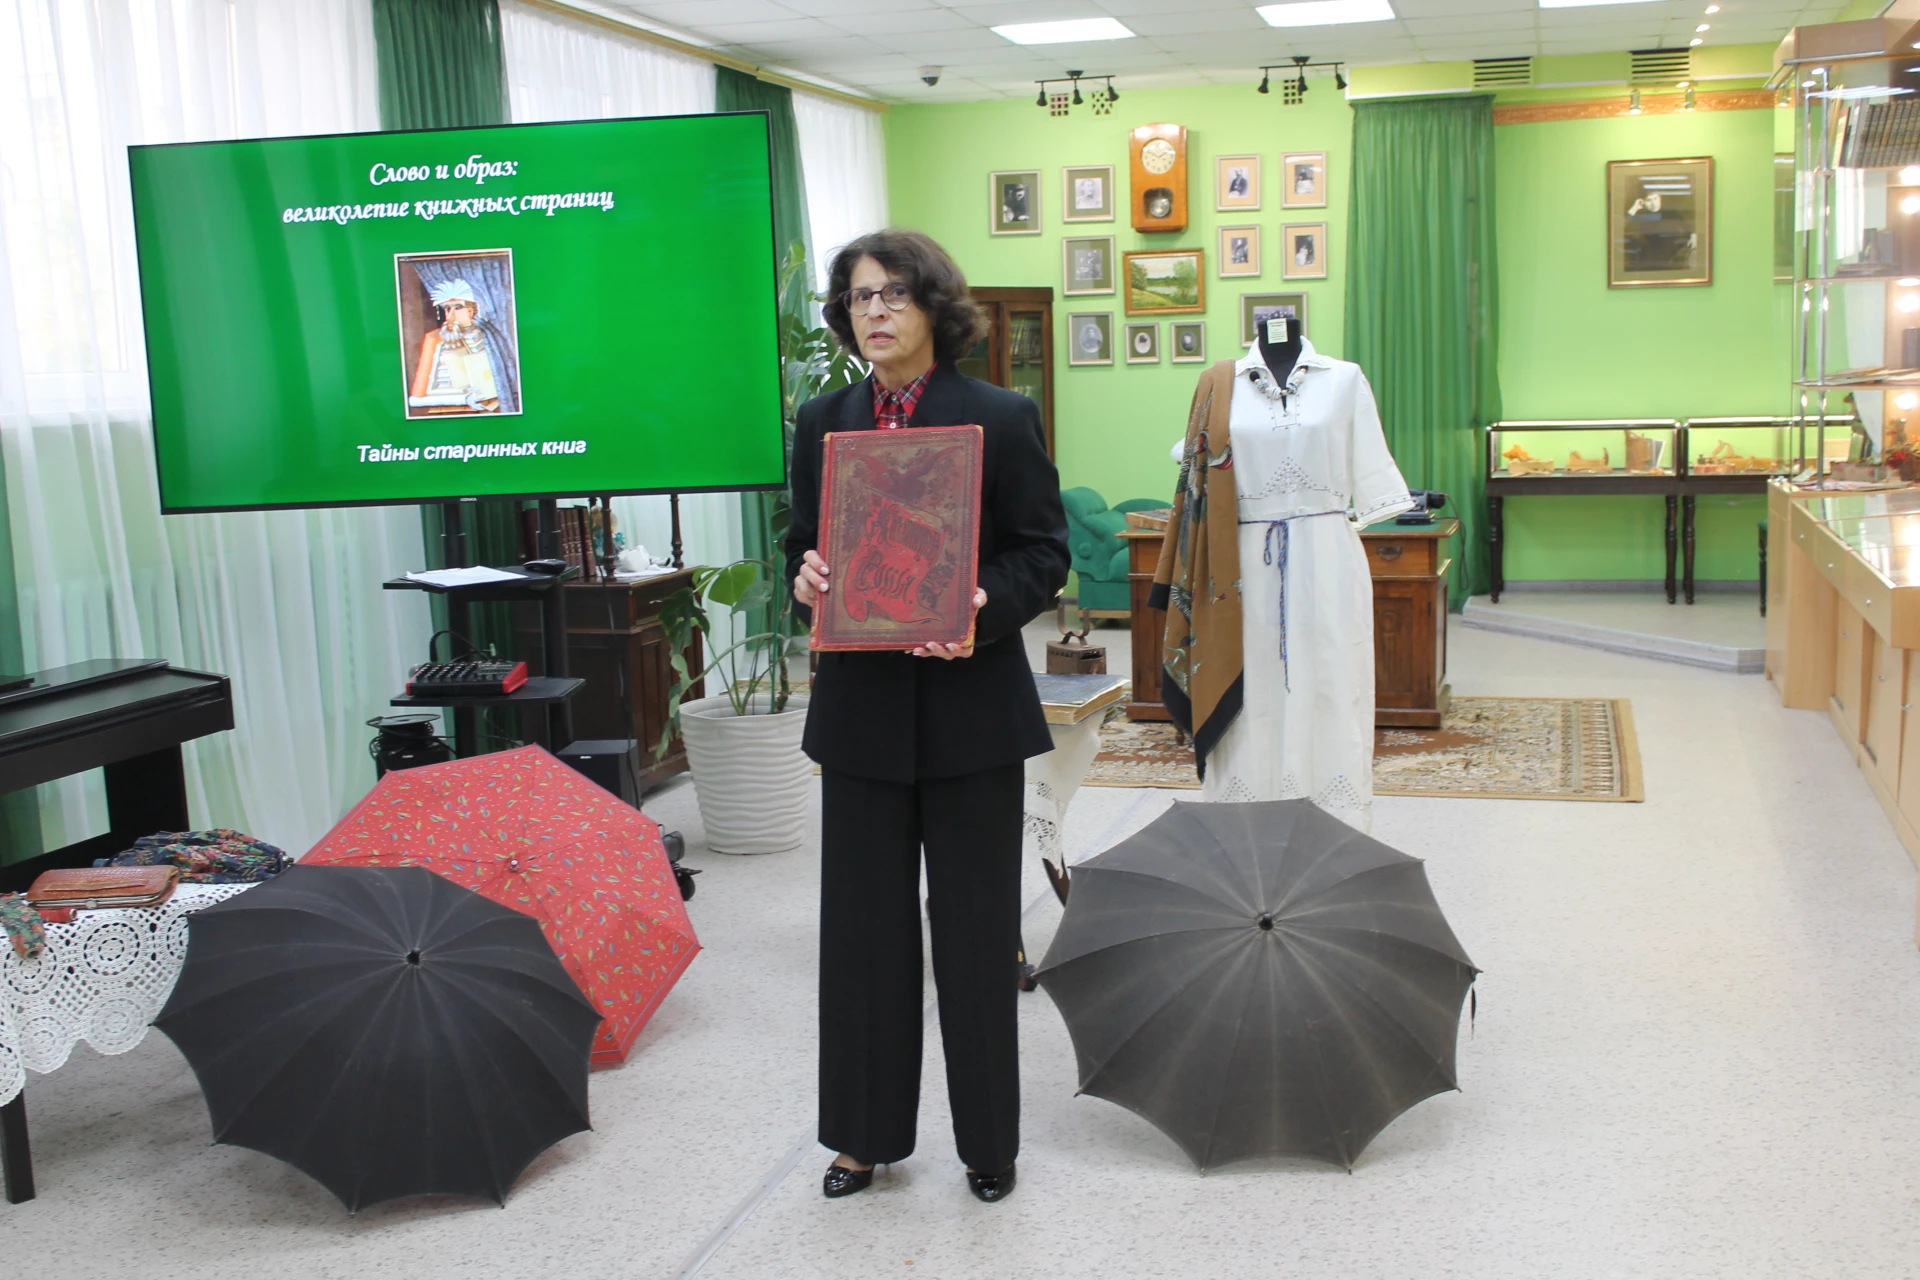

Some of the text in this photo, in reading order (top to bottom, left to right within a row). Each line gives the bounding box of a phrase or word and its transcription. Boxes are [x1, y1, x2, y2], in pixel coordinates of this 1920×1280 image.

[369, 154, 519, 186] Слово и образ:
[281, 191, 615, 226] великолепие книжных страниц
[356, 438, 587, 463] Тайны старинных книг
